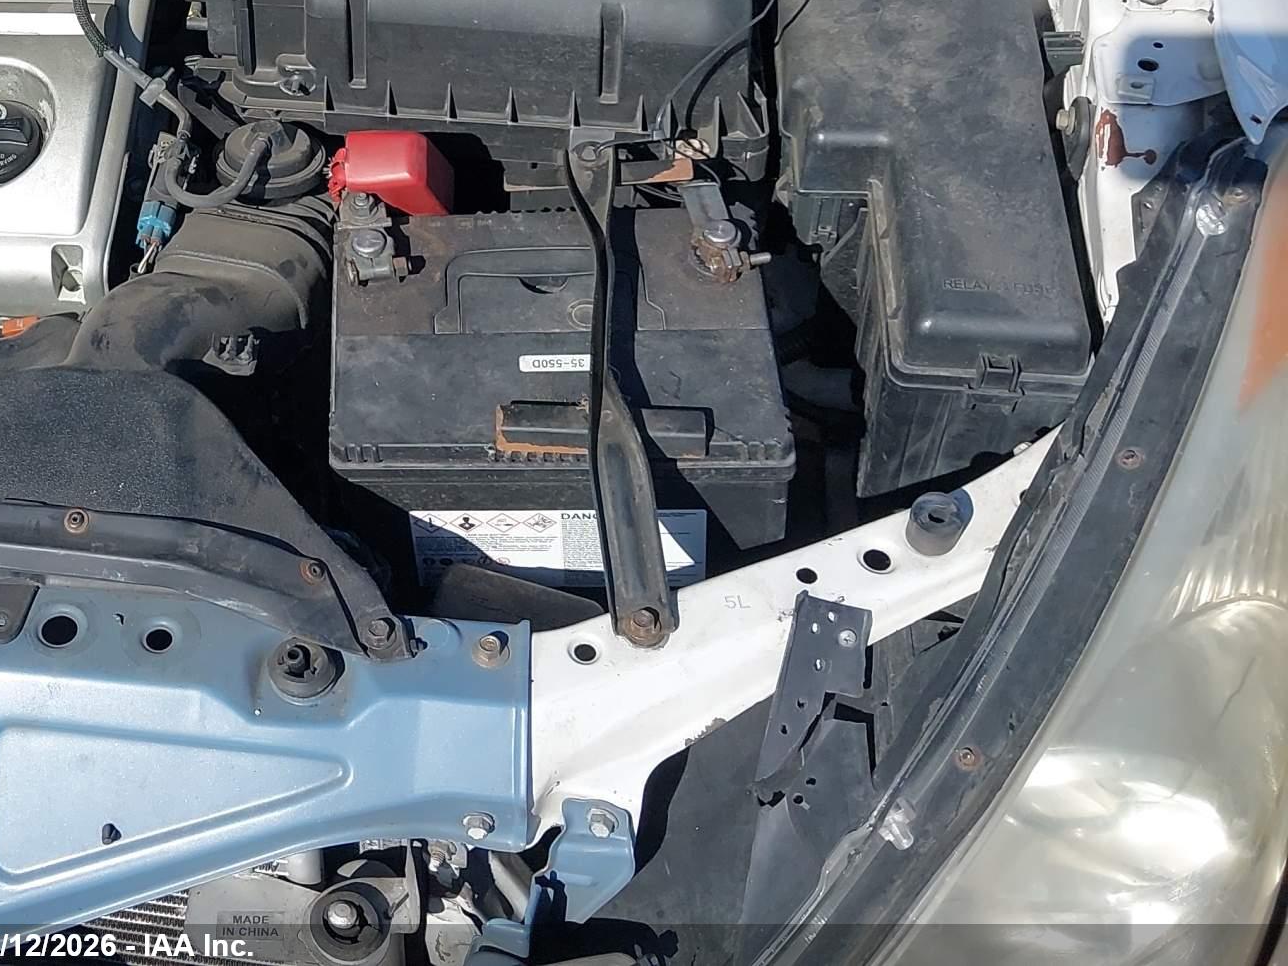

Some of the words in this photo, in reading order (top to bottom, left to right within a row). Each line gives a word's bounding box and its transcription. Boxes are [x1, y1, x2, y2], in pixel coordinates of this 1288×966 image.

[943, 278, 991, 291] RELAY
[532, 358, 585, 369] 35-550D
[723, 594, 752, 609] 5L
[232, 915, 271, 924] MADE
[222, 927, 234, 936] IN
[238, 927, 279, 937] CHINA
